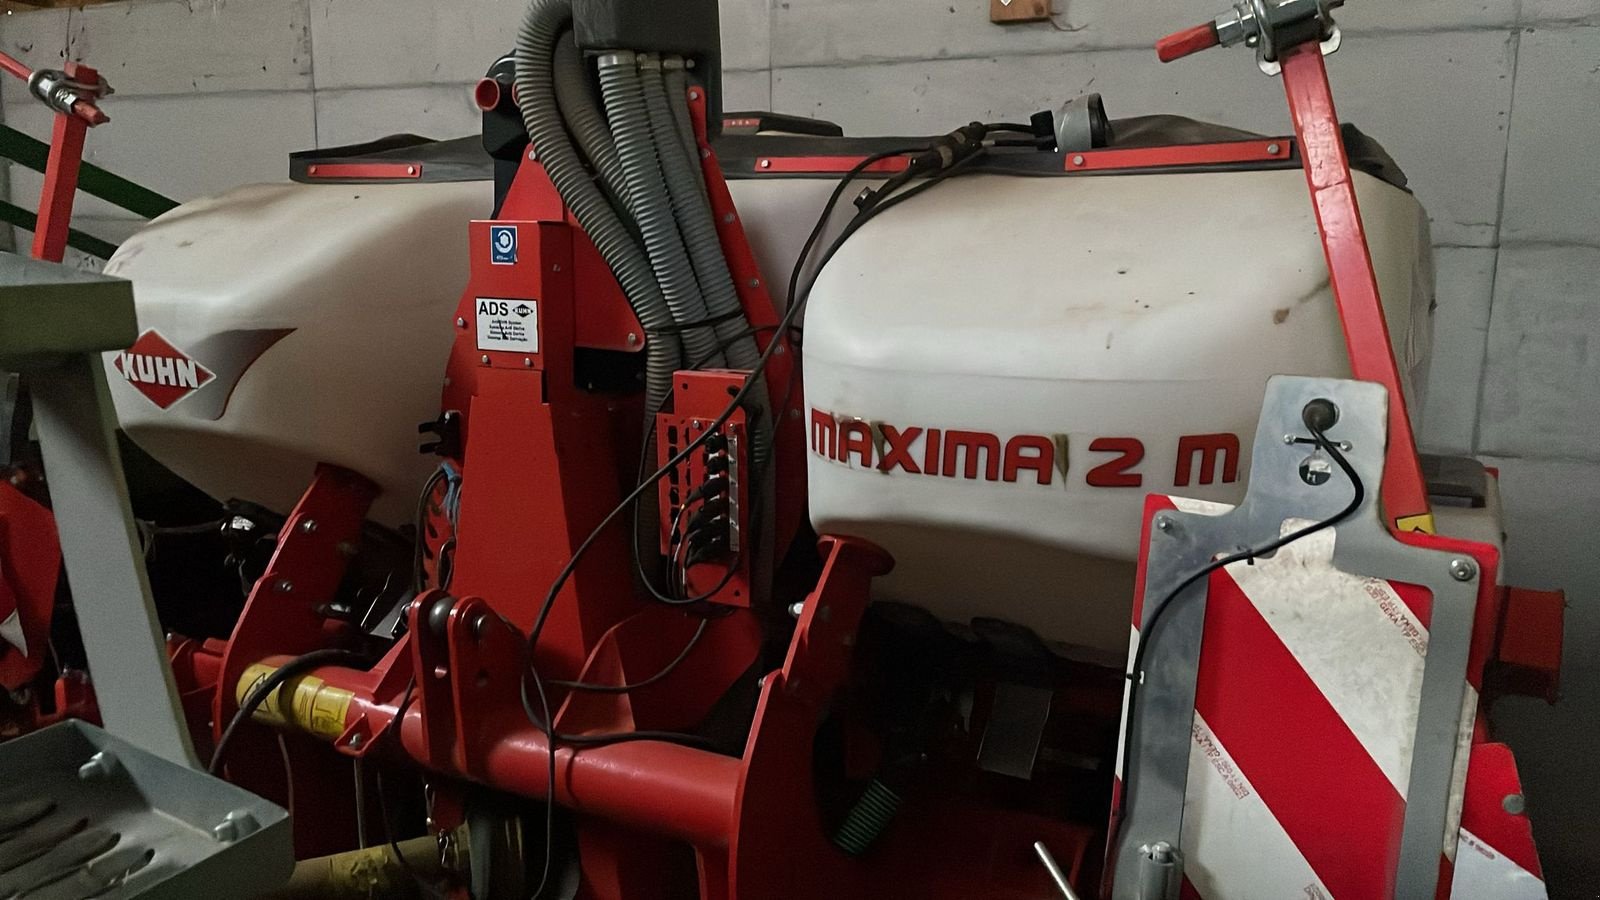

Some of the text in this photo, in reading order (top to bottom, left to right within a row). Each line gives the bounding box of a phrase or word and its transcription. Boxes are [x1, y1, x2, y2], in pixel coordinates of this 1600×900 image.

[479, 301, 508, 316] ADS
[121, 352, 199, 389] KUHN
[811, 407, 1240, 487] MAXIMA 2 M
